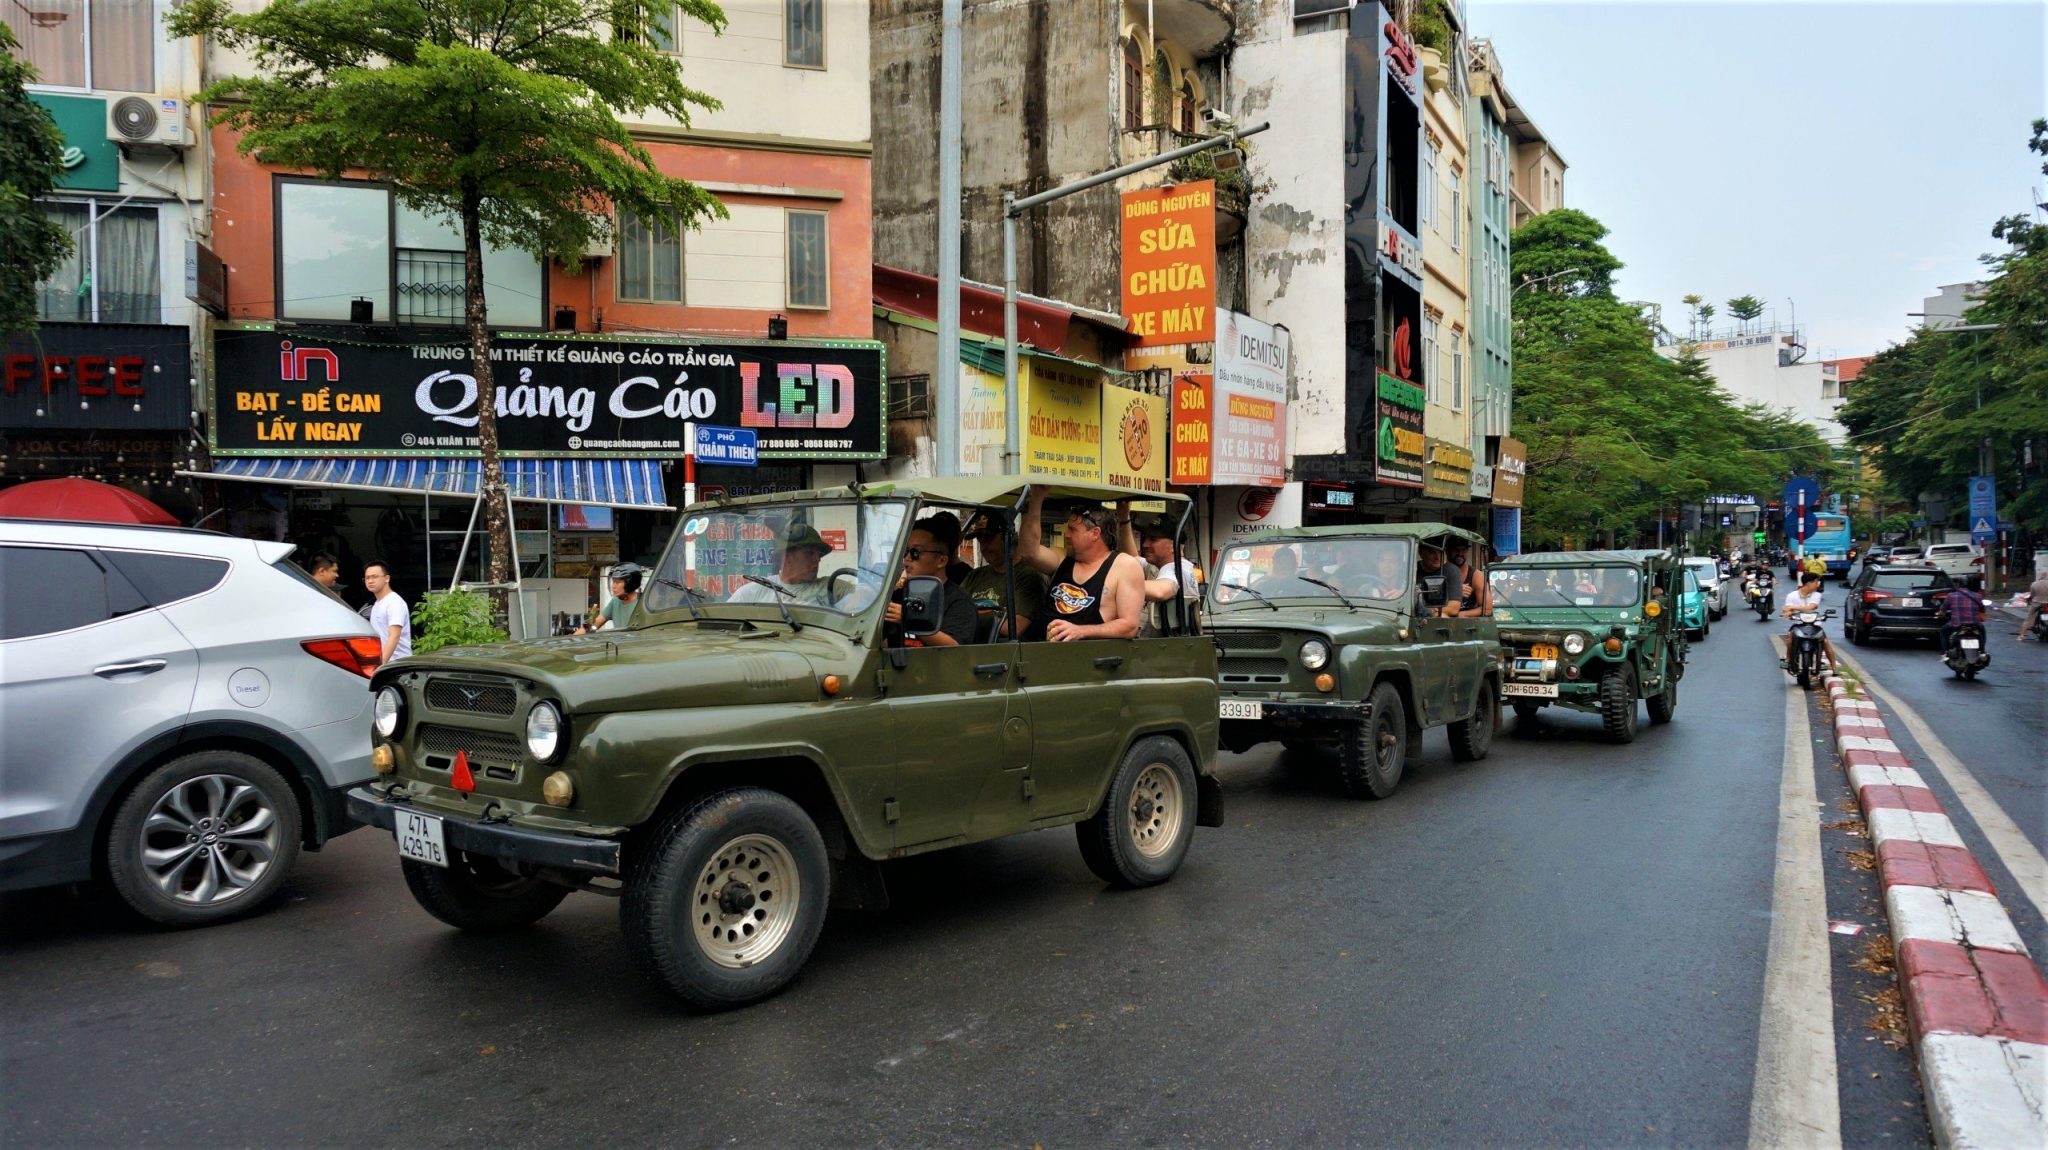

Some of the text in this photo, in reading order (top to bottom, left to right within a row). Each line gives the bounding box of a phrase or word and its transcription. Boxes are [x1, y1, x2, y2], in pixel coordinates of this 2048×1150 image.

[1126, 192, 1210, 218] DŨNG NGUYÊN
[1139, 218, 1196, 254] SỬA
[1130, 262, 1206, 296] CHỮA
[1132, 302, 1205, 337] XE MÁY
[280, 340, 339, 381] in
[411, 343, 735, 366] TRUNG TM THIẾT KẾ QUẢNG CÁO TRẦN GIA
[1240, 333, 1285, 369] IDEMITSU
[236, 391, 280, 416] BẠT
[302, 387, 331, 412] ĐỀ
[336, 394, 381, 413] CAN
[608, 371, 717, 420] Cáo
[740, 362, 855, 428] LED
[1181, 384, 1205, 409] SỬA
[257, 415, 362, 441] LẤY NGAY
[717, 430, 735, 441] PHỐ
[1176, 420, 1208, 443] CHỮA
[436, 436, 463, 446] KHÂM
[466, 437, 480, 446] THI
[699, 443, 755, 460] KHÂM THIÊN
[757, 440, 767, 448] 17
[1221, 438, 1233, 457] XE
[1268, 438, 1281, 461] SỐ
[1177, 453, 1208, 476] XE MÁY
[1134, 477, 1142, 490] 10
[1144, 478, 1161, 492] WON
[236, 685, 260, 693] Diesel
[1503, 685, 1553, 695] 30H-609.34
[1220, 703, 1257, 718] 339.91
[409, 815, 429, 838] 47A
